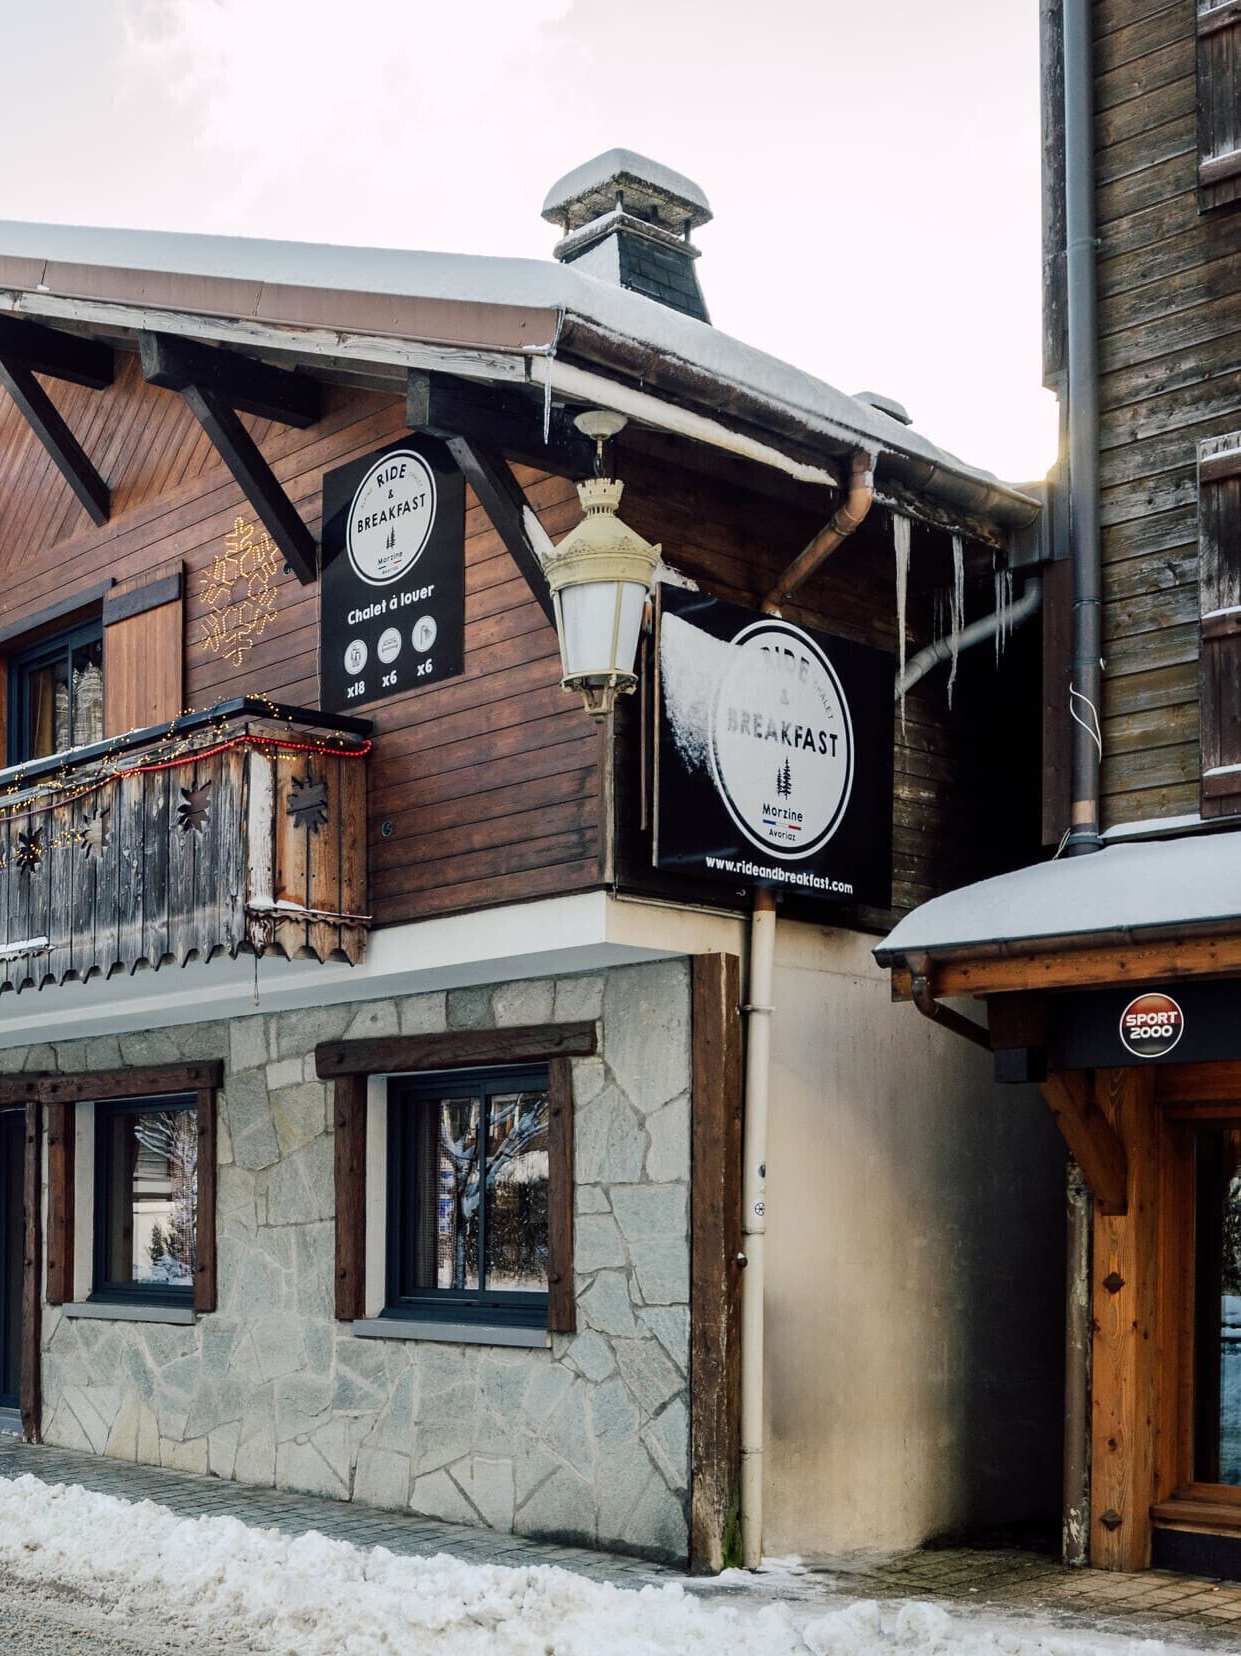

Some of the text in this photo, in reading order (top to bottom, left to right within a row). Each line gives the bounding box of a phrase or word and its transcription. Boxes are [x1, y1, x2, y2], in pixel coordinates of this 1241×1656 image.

[376, 463, 407, 489] RIDE
[387, 488, 395, 500] &
[357, 493, 426, 534] BREAKFAST
[347, 599, 388, 625] Chalet
[400, 584, 435, 607] louer
[381, 669, 398, 688] x6
[416, 658, 434, 677] x6
[727, 706, 839, 758] BREAKFAST
[762, 802, 803, 823] Morzine
[768, 828, 797, 841] Avoriaz
[705, 855, 854, 895] www.rideandbreakfast.com
[1125, 1010, 1178, 1027] SPORT
[1129, 1024, 1173, 1039] 2000
